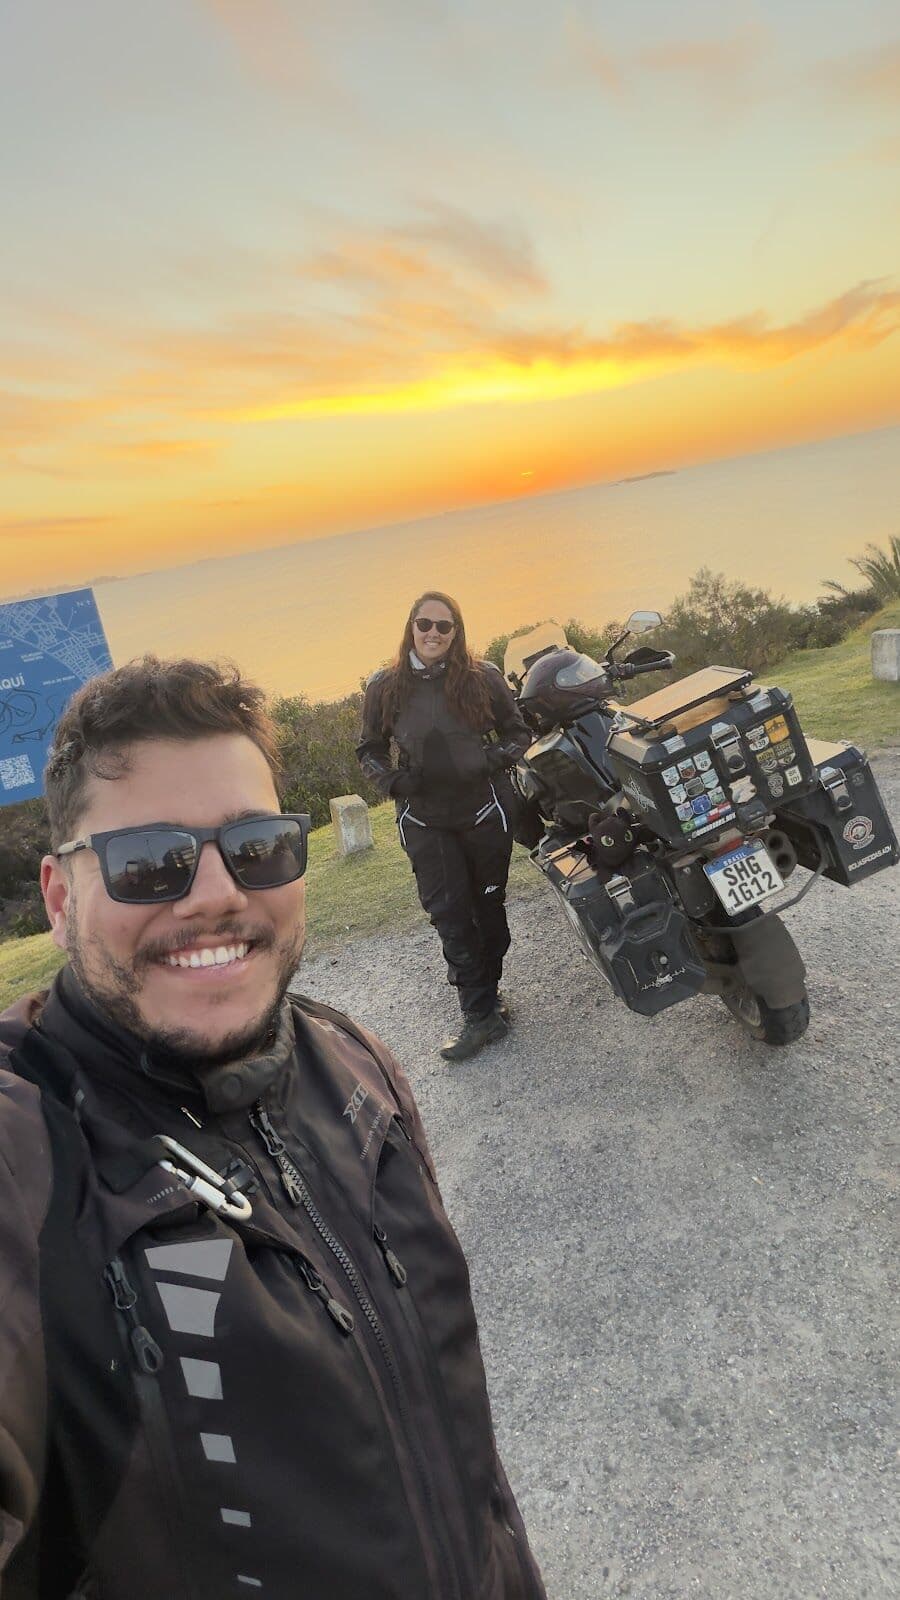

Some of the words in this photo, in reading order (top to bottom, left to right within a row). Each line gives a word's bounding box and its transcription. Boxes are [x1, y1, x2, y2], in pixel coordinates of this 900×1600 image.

[722, 855, 762, 887] SHG
[723, 851, 747, 867] BRASIL
[728, 871, 778, 908] 1G12
